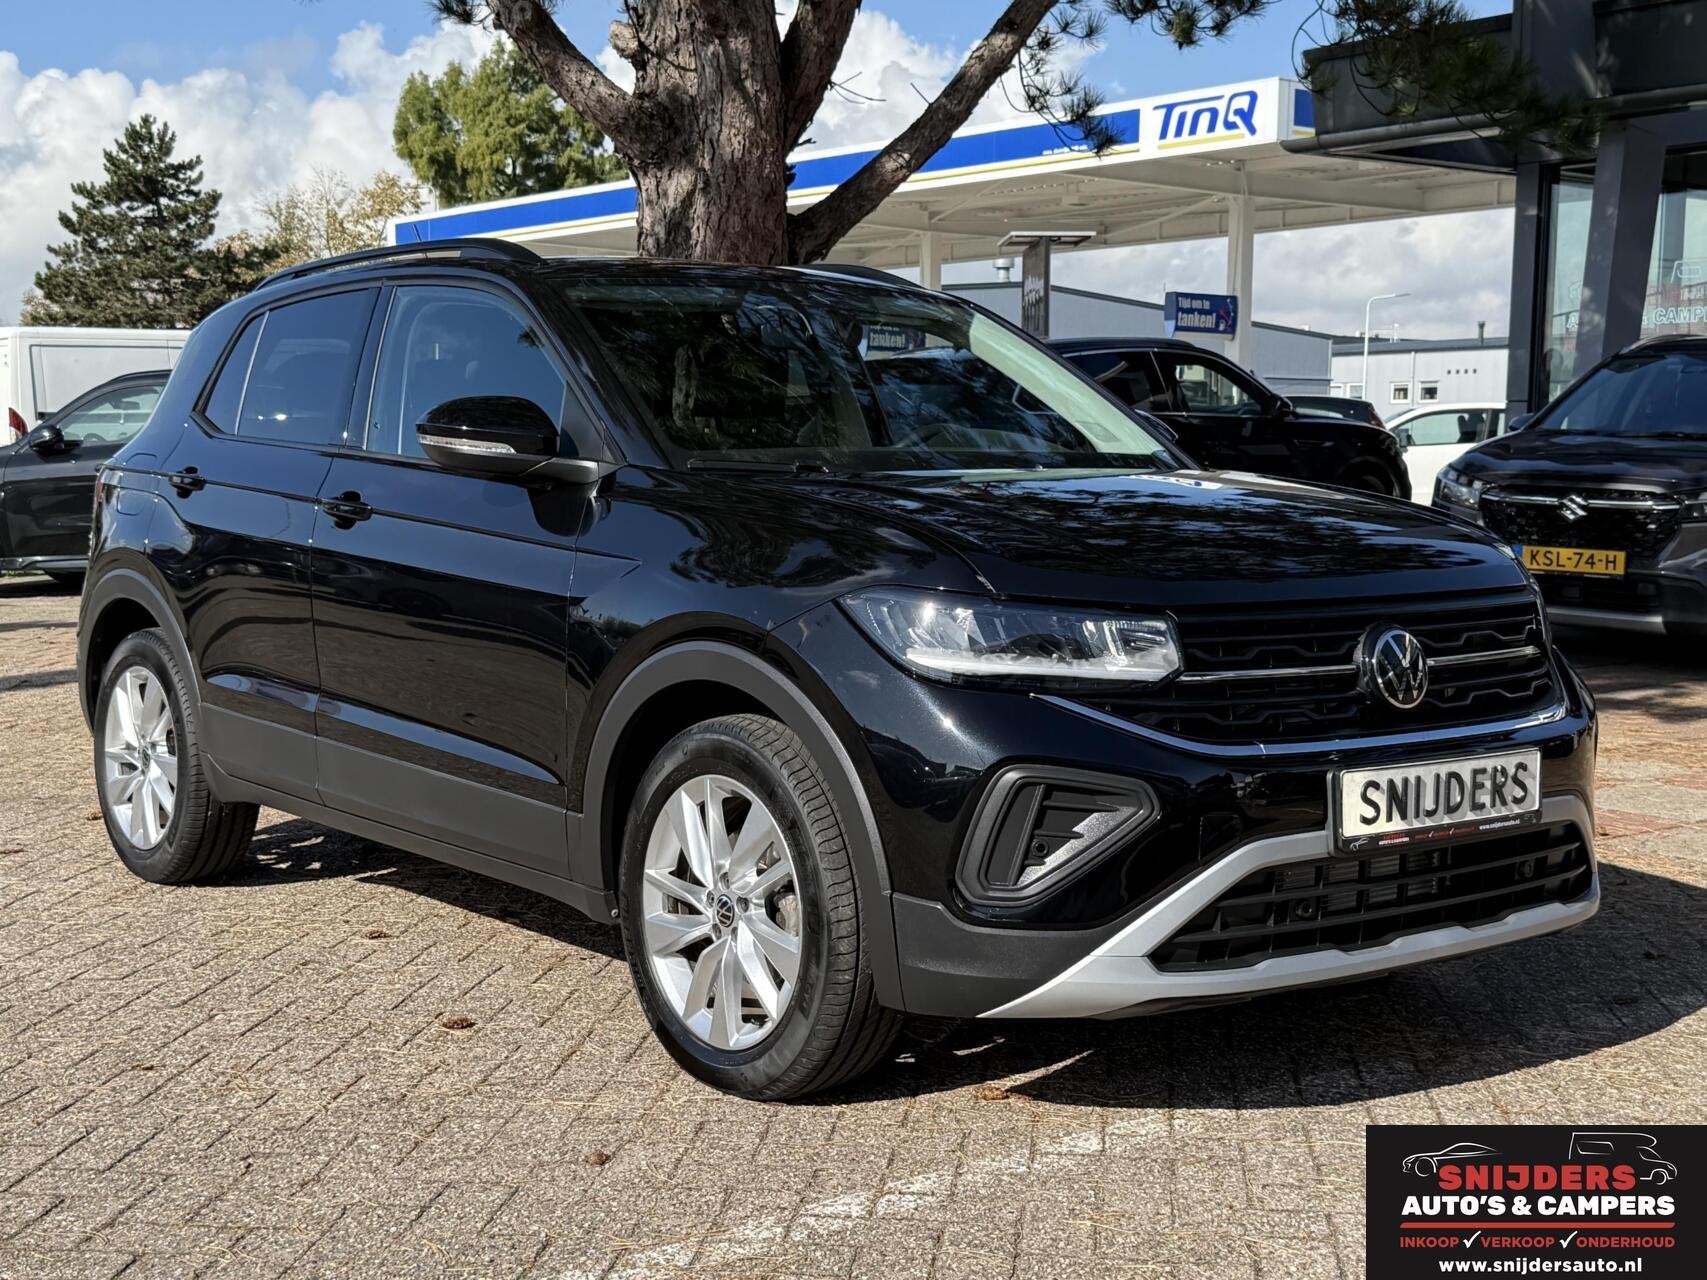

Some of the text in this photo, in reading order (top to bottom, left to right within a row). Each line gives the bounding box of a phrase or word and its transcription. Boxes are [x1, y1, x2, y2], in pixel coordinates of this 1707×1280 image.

[1178, 296, 1210, 310] Tijd om te
[1177, 311, 1216, 328] tanken!
[869, 331, 906, 348] tanken!
[1529, 549, 1617, 571] KSL-74-H
[1359, 761, 1529, 826] SNIJDERS
